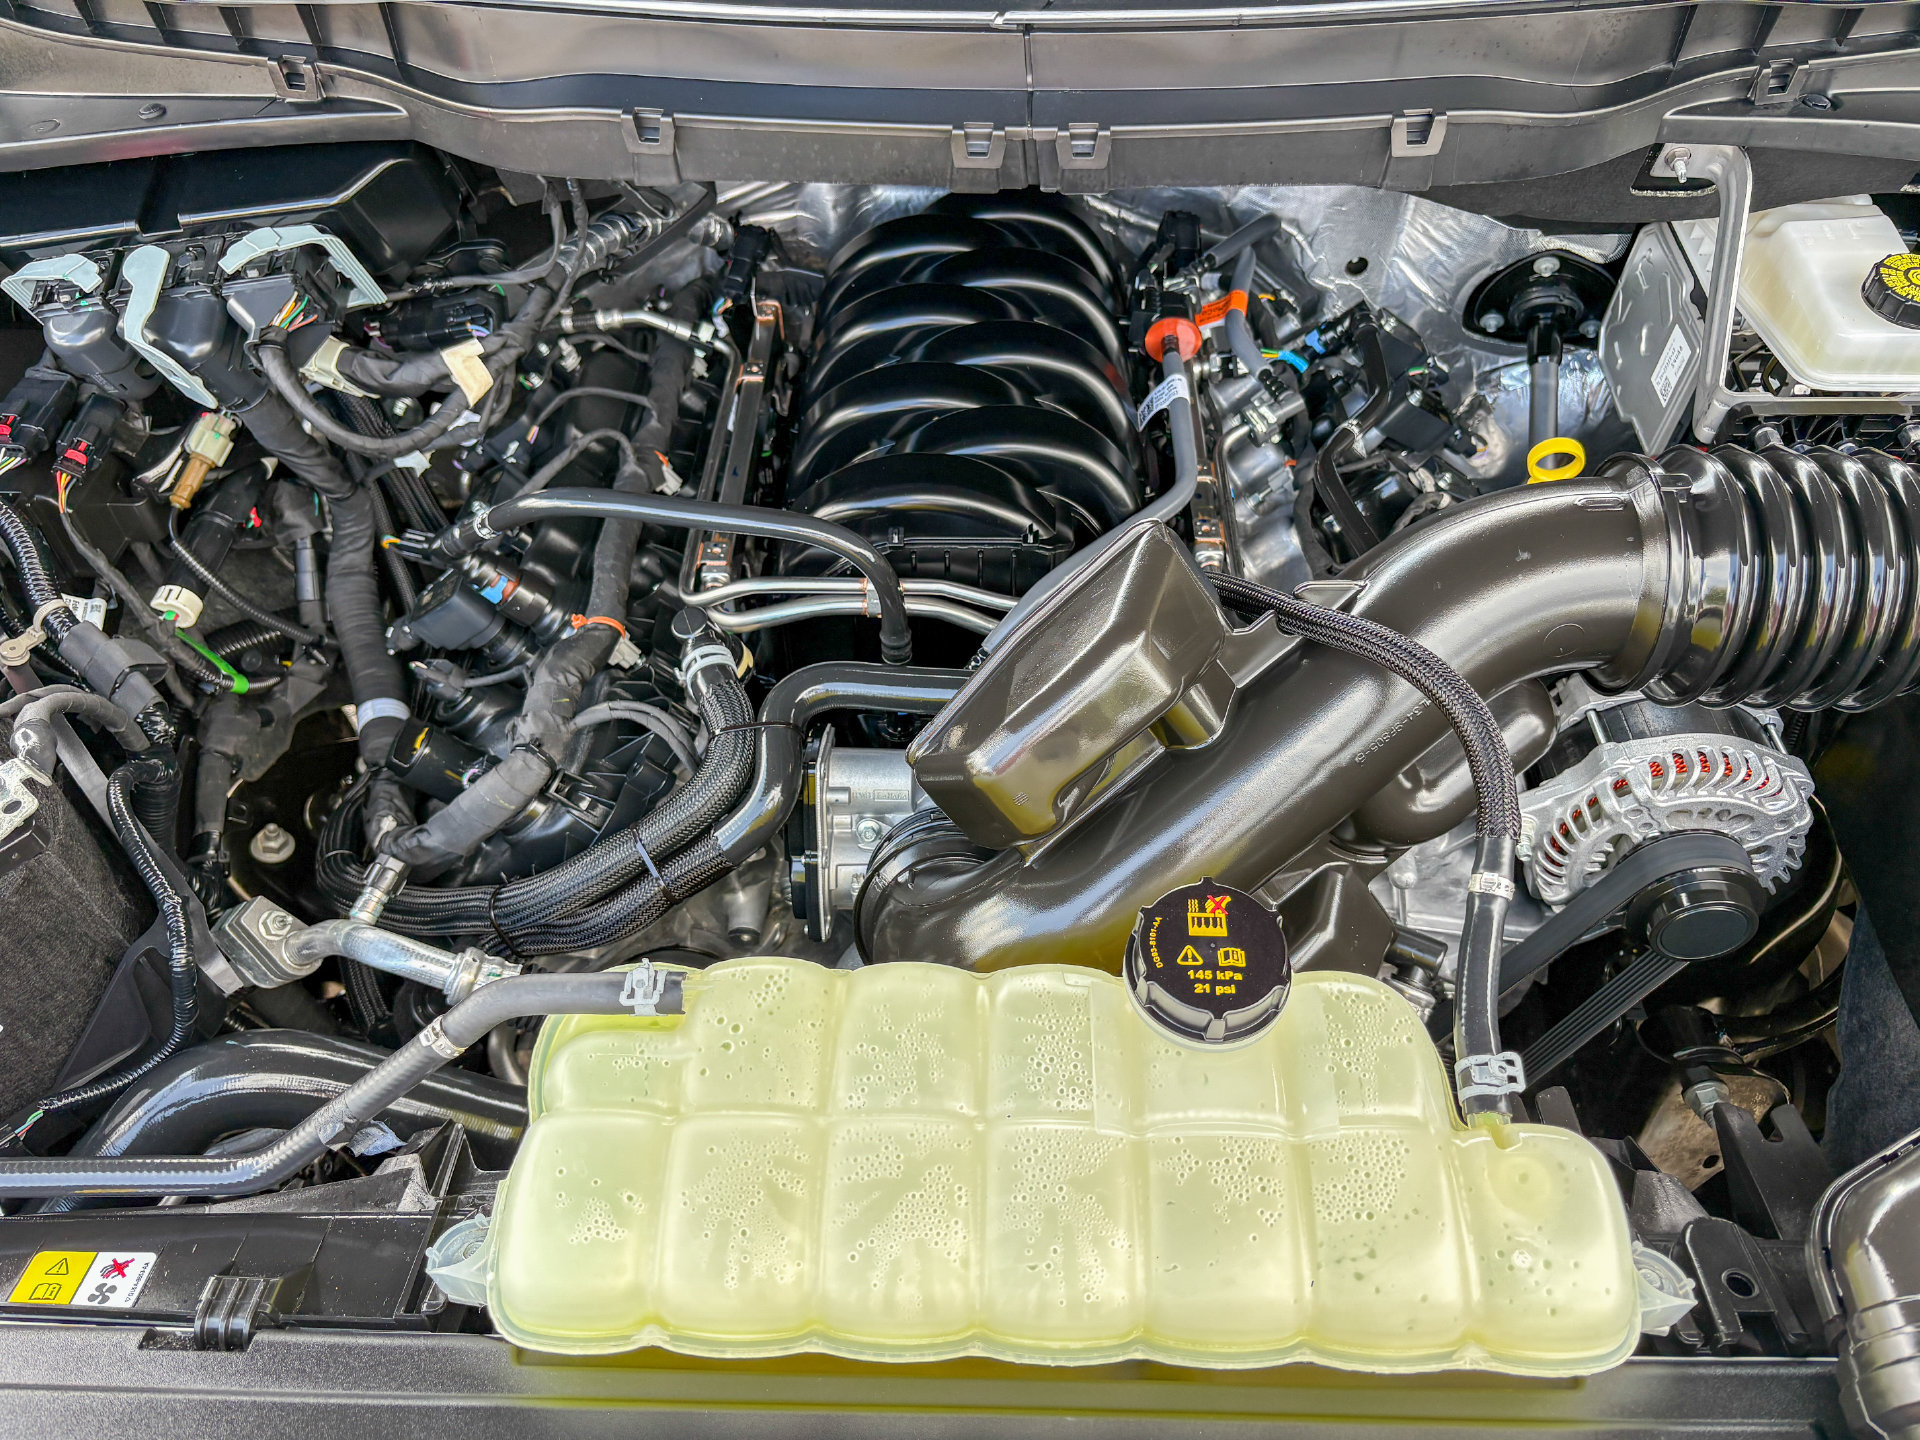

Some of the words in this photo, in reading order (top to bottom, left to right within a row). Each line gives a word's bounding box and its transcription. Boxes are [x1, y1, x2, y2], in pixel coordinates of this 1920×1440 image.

[1187, 970, 1212, 980] 145
[1216, 969, 1243, 980] kPa
[1194, 984, 1210, 994] 21
[1215, 984, 1236, 996] psi
